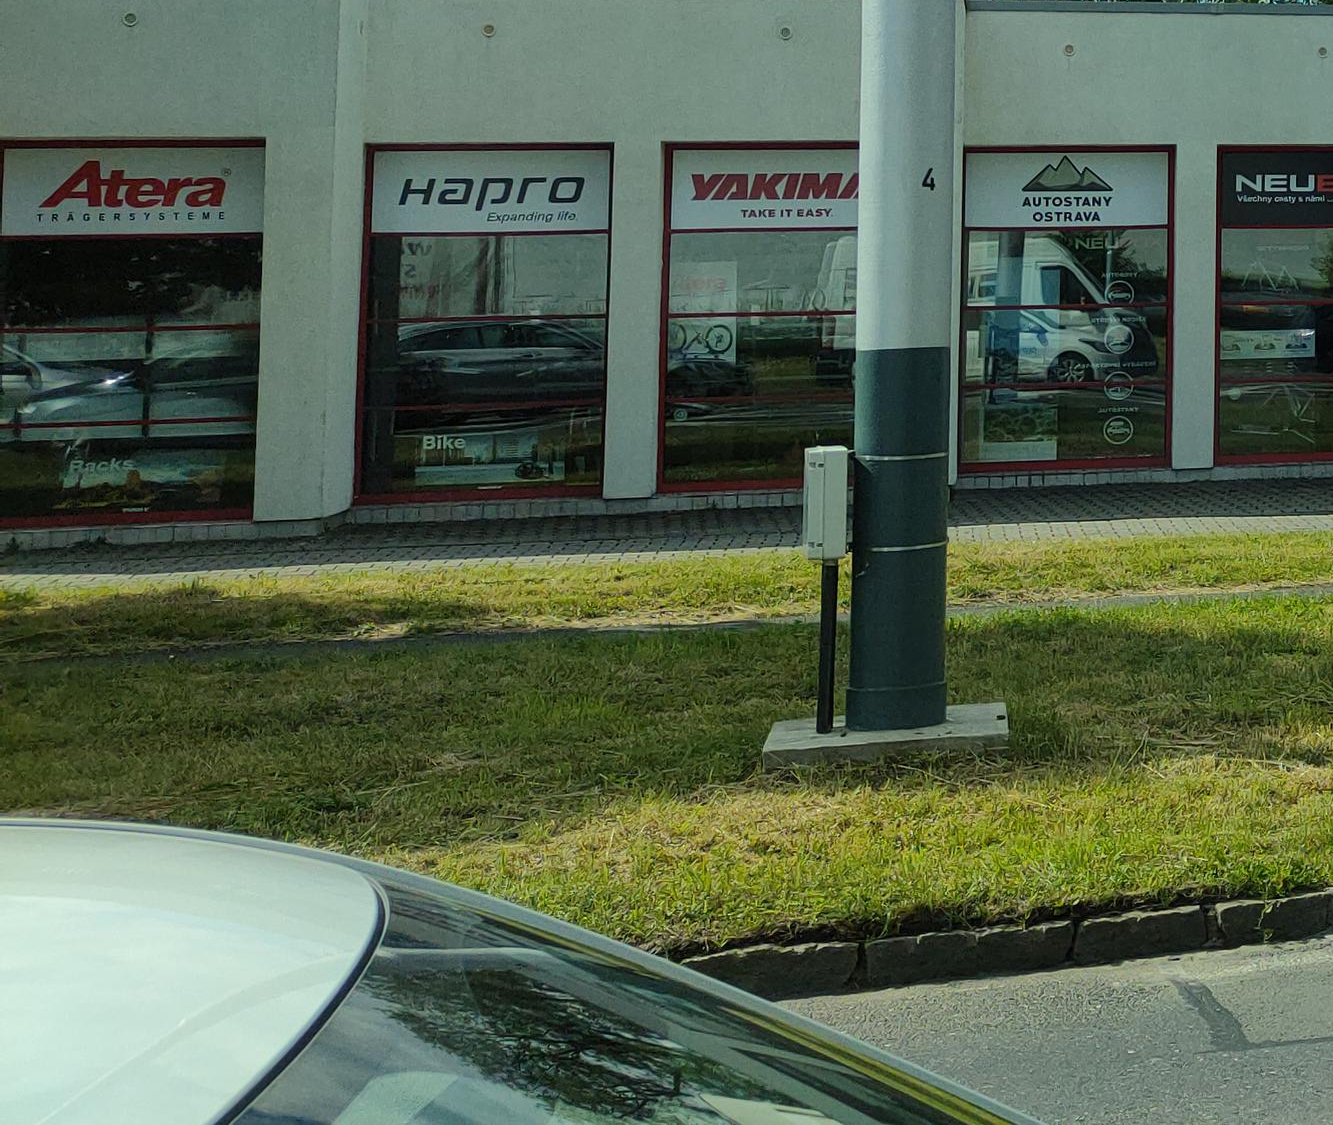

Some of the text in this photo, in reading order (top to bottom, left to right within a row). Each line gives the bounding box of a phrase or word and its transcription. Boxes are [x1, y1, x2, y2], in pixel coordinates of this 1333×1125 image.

[38, 160, 226, 208] Atera
[921, 167, 936, 191] 4
[398, 177, 585, 211] Hapro
[1022, 196, 1113, 207] AUTOSTANY
[37, 211, 225, 222] TRÄGERSYSTEME
[487, 212, 553, 224] Expanding
[741, 209, 776, 218] TAKE
[780, 209, 793, 218] IT
[1033, 212, 1101, 222] OSTRAVA
[422, 435, 466, 450] Bike
[69, 457, 135, 475] Racks
